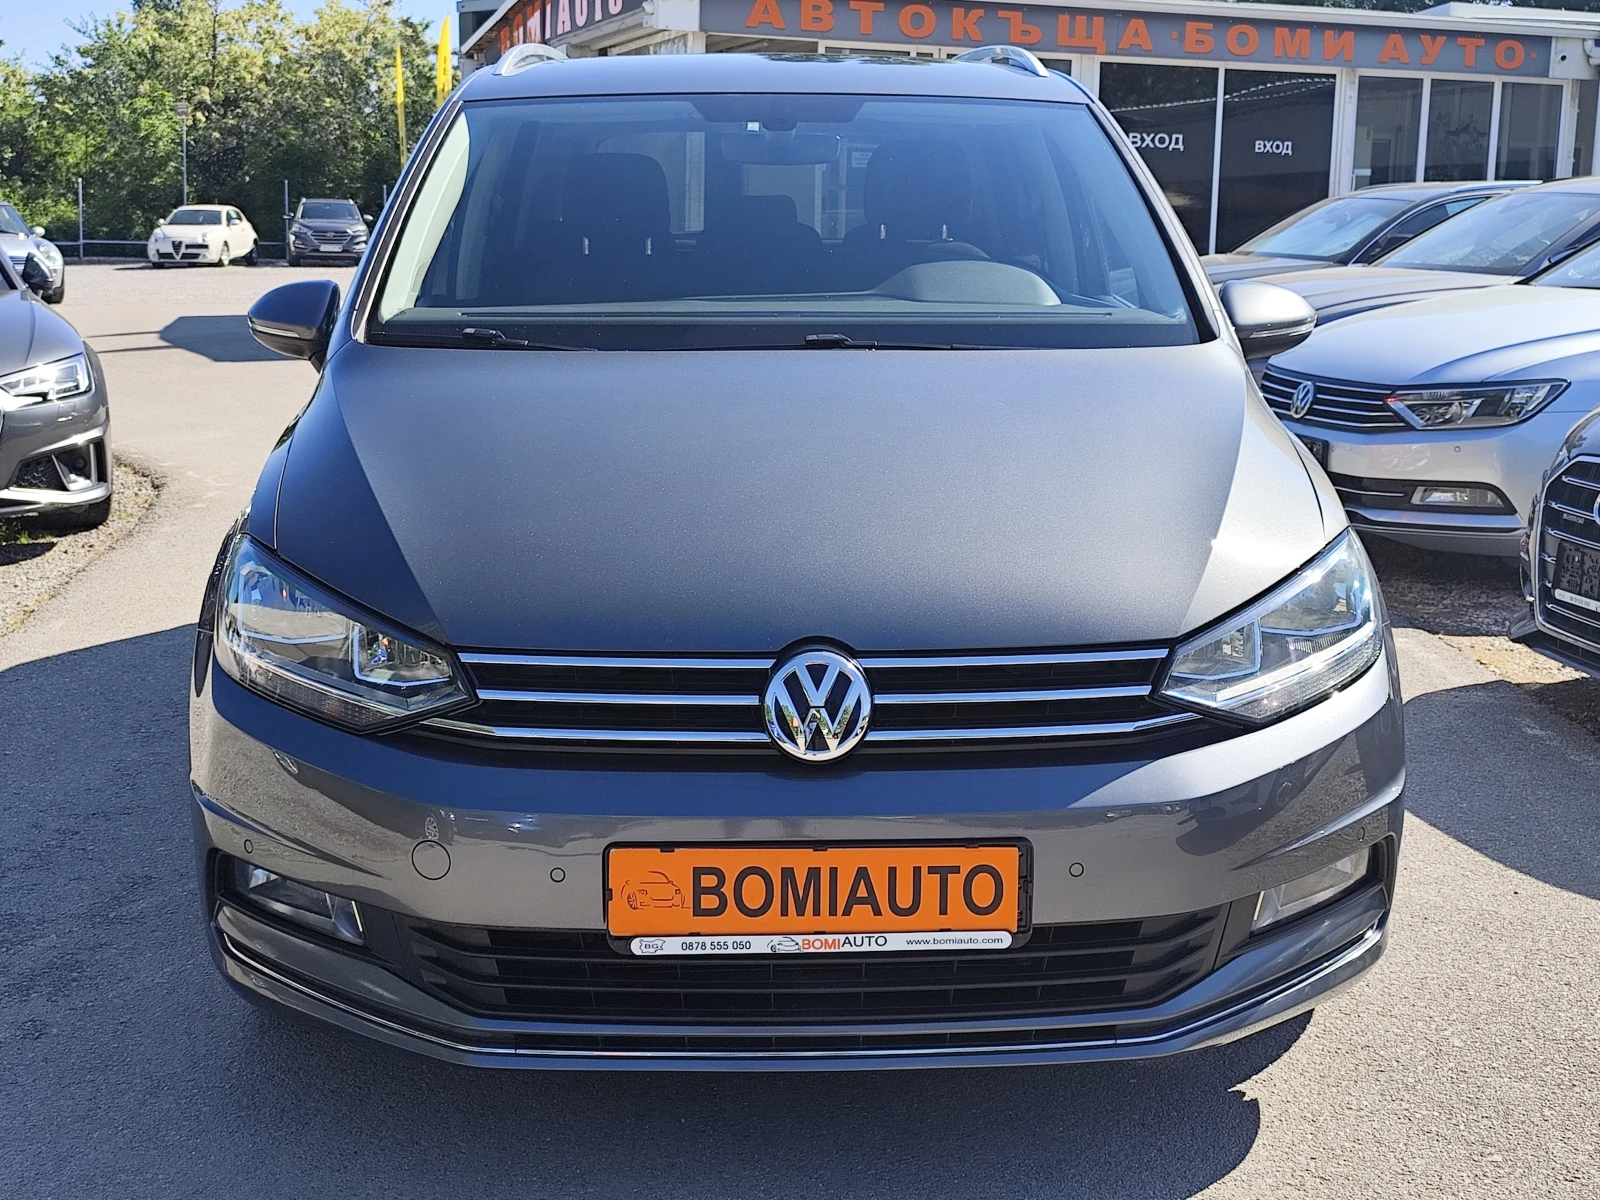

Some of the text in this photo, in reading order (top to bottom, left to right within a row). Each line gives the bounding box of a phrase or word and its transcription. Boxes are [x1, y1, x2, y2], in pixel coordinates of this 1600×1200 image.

[745, 0, 1526, 70] АВТОКЪЩА БОМИ АУТО
[1128, 132, 1185, 152] ВХОД
[1254, 140, 1293, 156] ВХОД
[691, 865, 1004, 918] BOMIAUTO
[681, 941, 707, 951] 0878
[709, 941, 729, 951] 555
[731, 940, 752, 950] 050
[905, 936, 1004, 946] www.bomiauto.com
